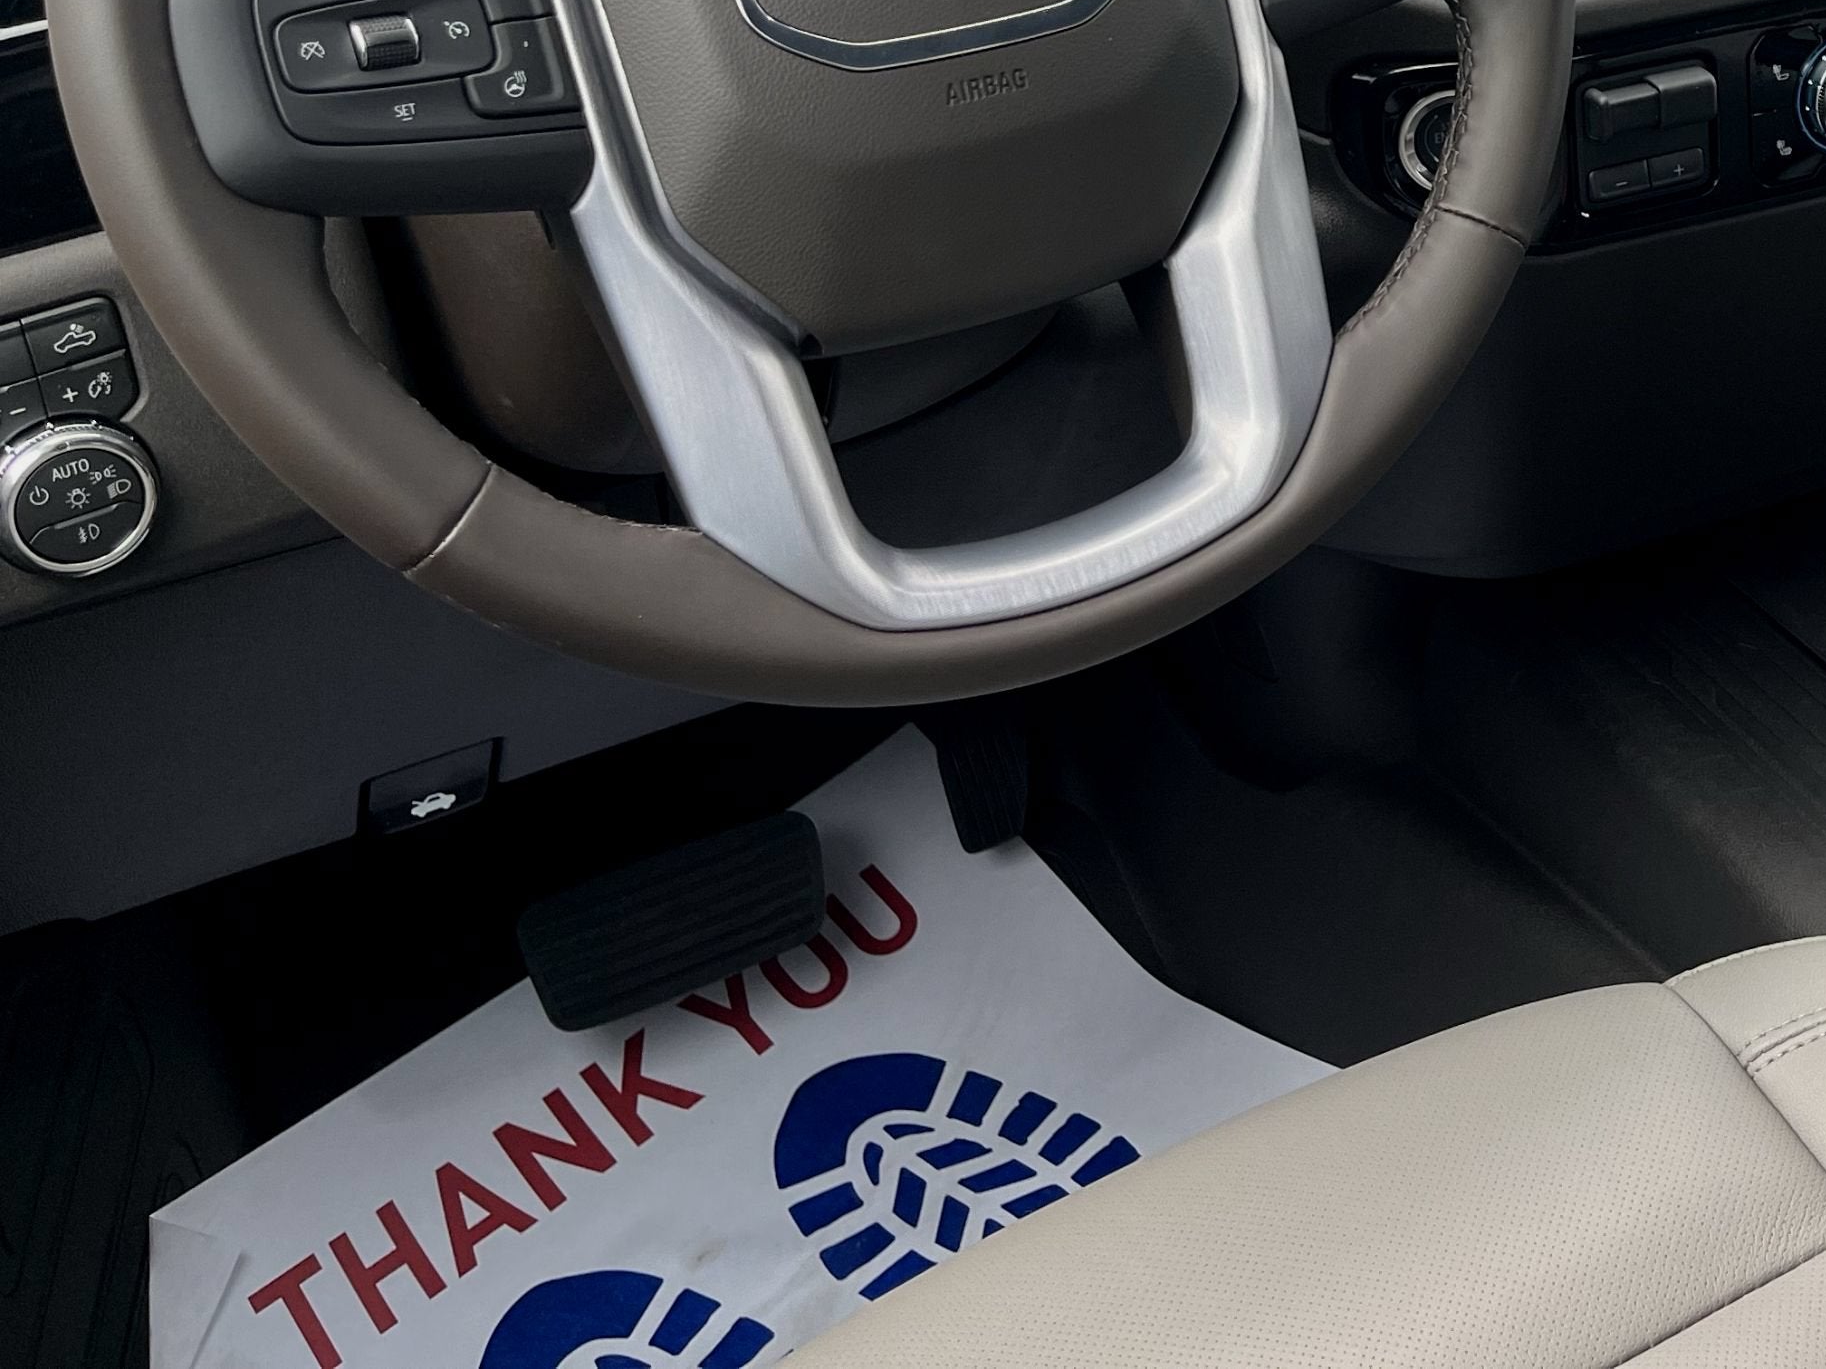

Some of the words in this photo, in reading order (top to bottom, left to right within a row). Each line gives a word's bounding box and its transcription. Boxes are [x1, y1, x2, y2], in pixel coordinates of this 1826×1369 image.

[945, 68, 1029, 106] AIRBAG
[394, 102, 416, 117] SET
[51, 458, 90, 482] AUTO
[248, 1027, 706, 1369] THANK
[676, 863, 918, 1057] YOU
